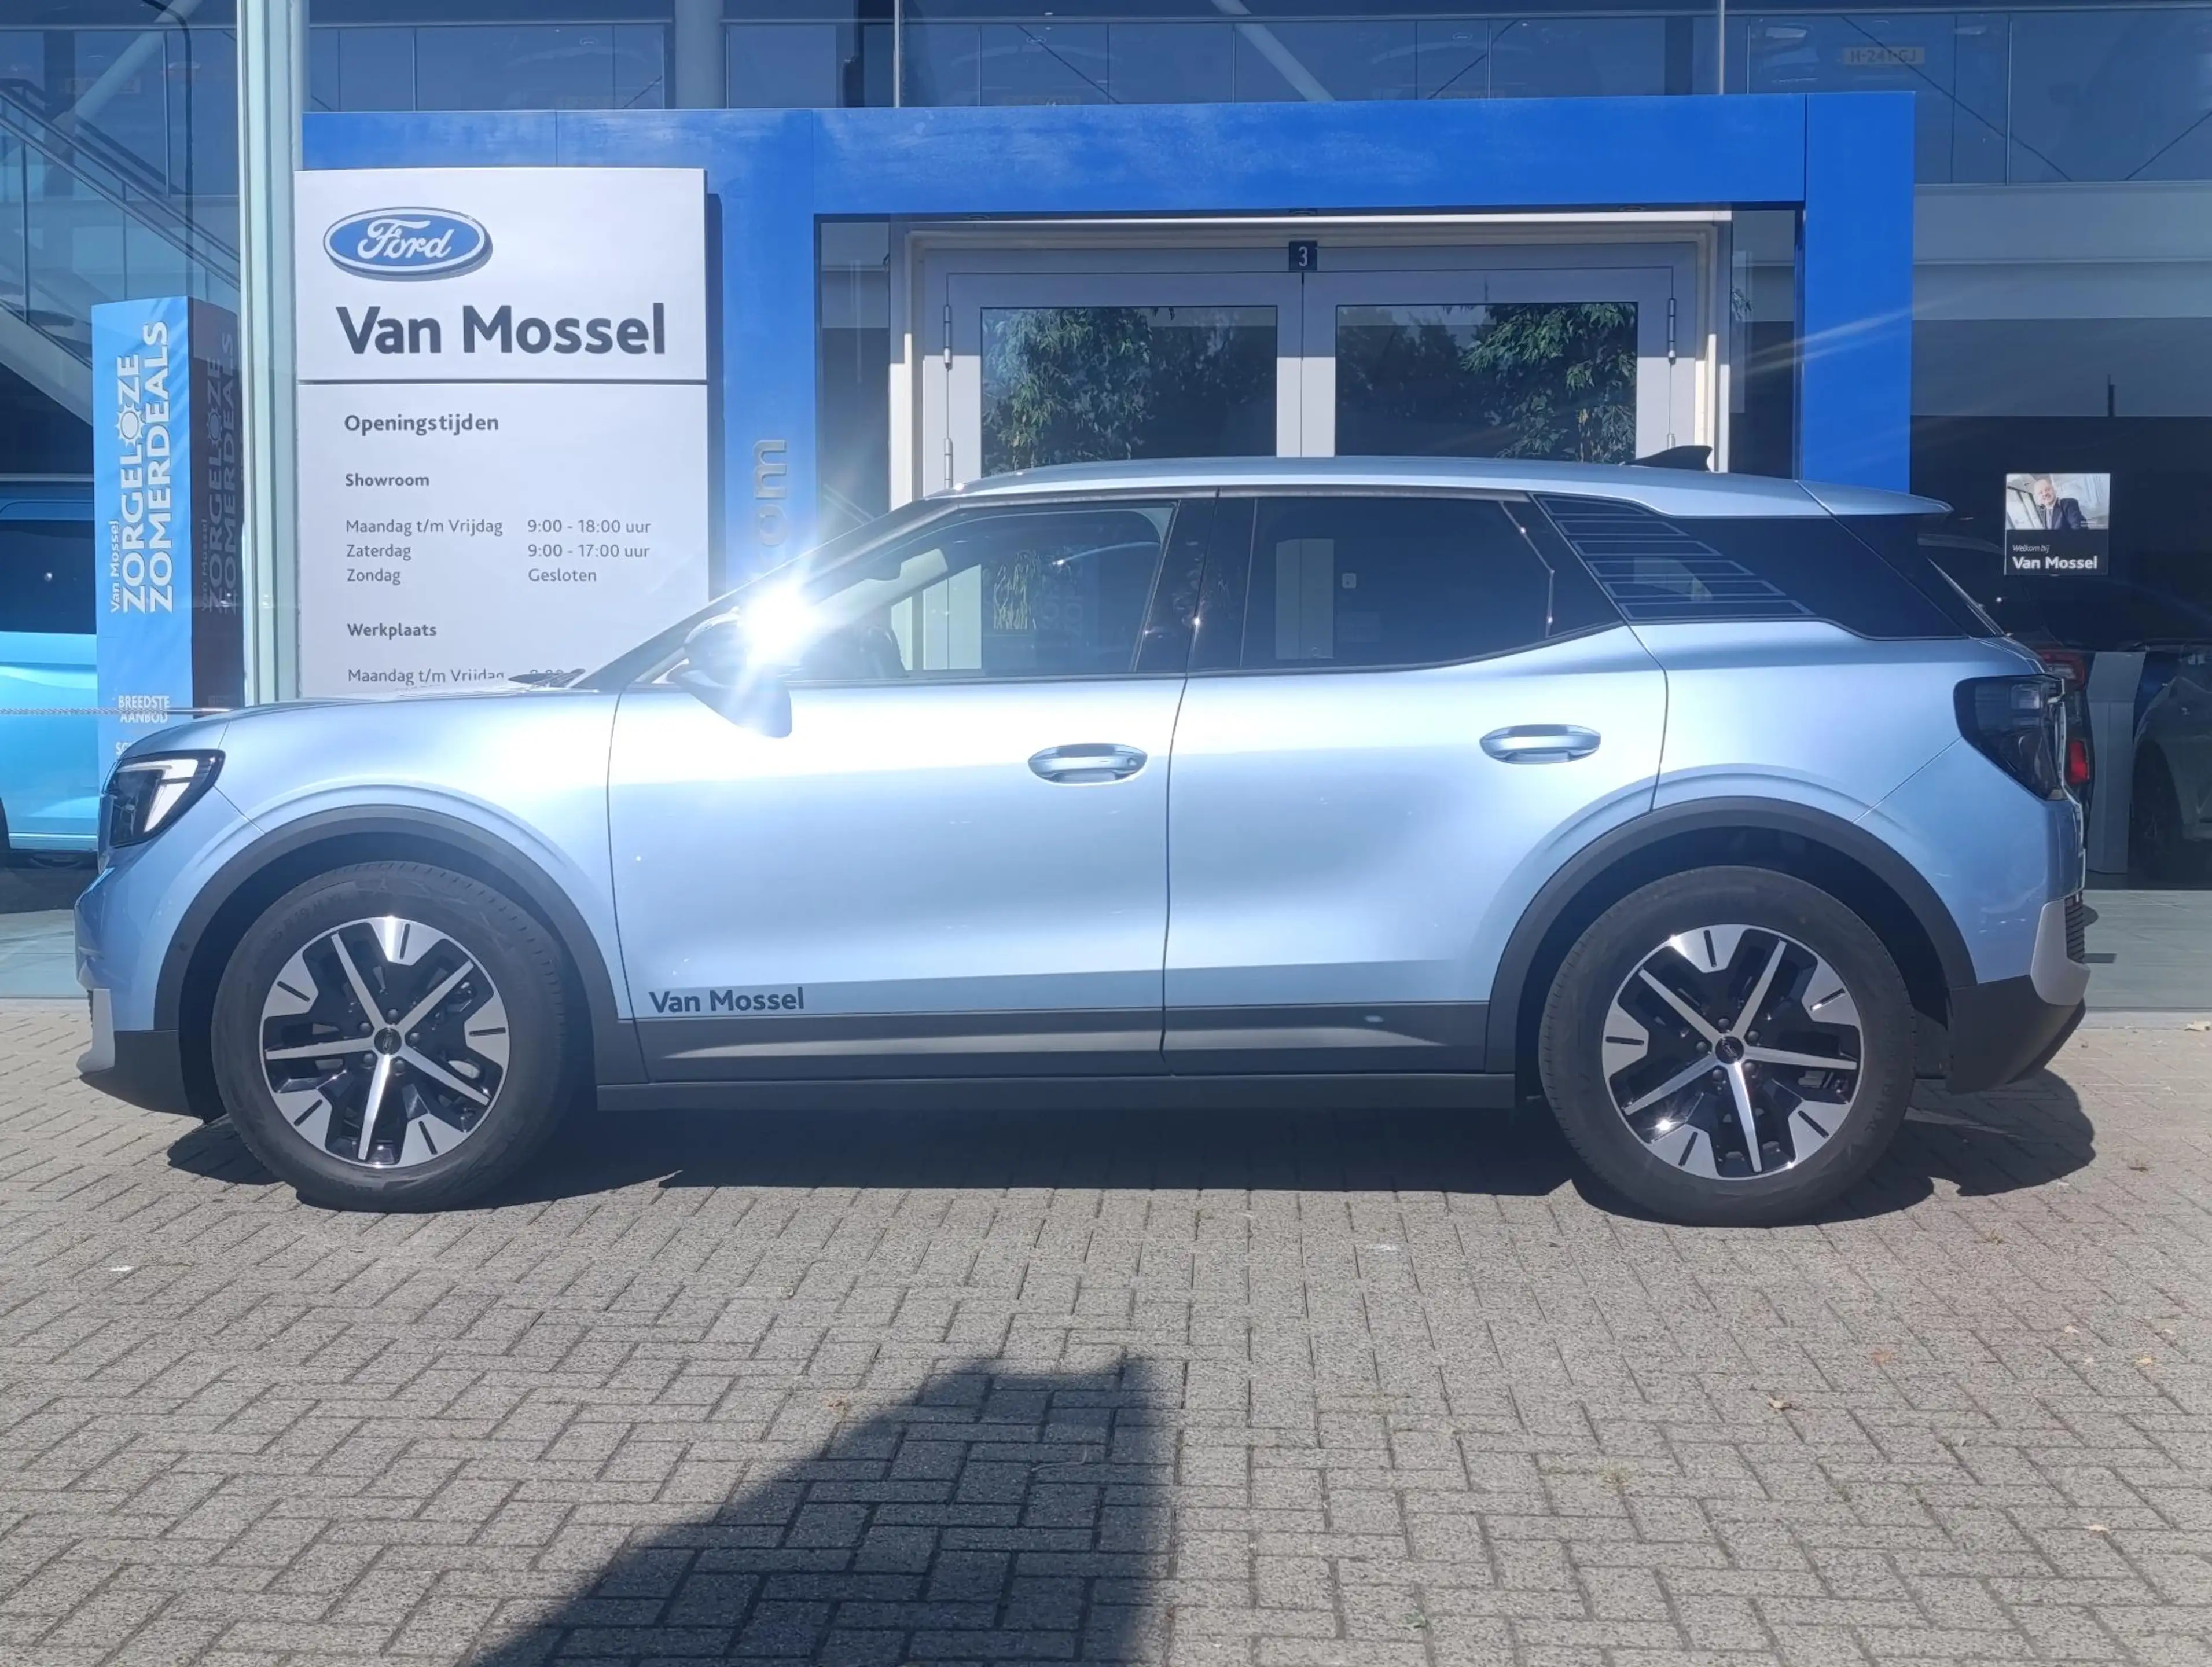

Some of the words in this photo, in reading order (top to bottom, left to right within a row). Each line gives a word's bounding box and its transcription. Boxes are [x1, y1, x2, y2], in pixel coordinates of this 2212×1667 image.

[357, 219, 454, 259] Ford
[1298, 246, 1308, 266] 3
[336, 306, 441, 354] Van
[463, 303, 665, 354] Mossel
[344, 413, 499, 437] Openingstijden
[143, 321, 172, 614] ZOMERDEALS
[116, 354, 145, 614] ZORGELOZE
[346, 472, 429, 487] Showroom
[346, 519, 412, 537] Maandag
[416, 519, 444, 533] t/m
[448, 519, 503, 537] Vrijdag
[527, 519, 563, 533] 9:00
[578, 519, 621, 533] 18:00
[626, 523, 651, 533] uur
[108, 519, 120, 577] Mossel
[346, 543, 411, 561] Zaterdag
[528, 544, 563, 557] 9:00
[578, 544, 620, 557] 17:00
[624, 548, 650, 557] uur
[2012, 556, 2041, 569] Van
[2045, 555, 2098, 570] Mossel
[347, 567, 401, 586] Zondag
[528, 567, 597, 582] Gesloten
[110, 583, 120, 613] Van
[347, 622, 437, 641] Werkplaats
[348, 669, 414, 685] Maandag
[418, 669, 446, 682] t/m
[119, 695, 170, 708] BREEDSTE
[648, 991, 701, 1013] Van
[710, 986, 804, 1011] Mossel
